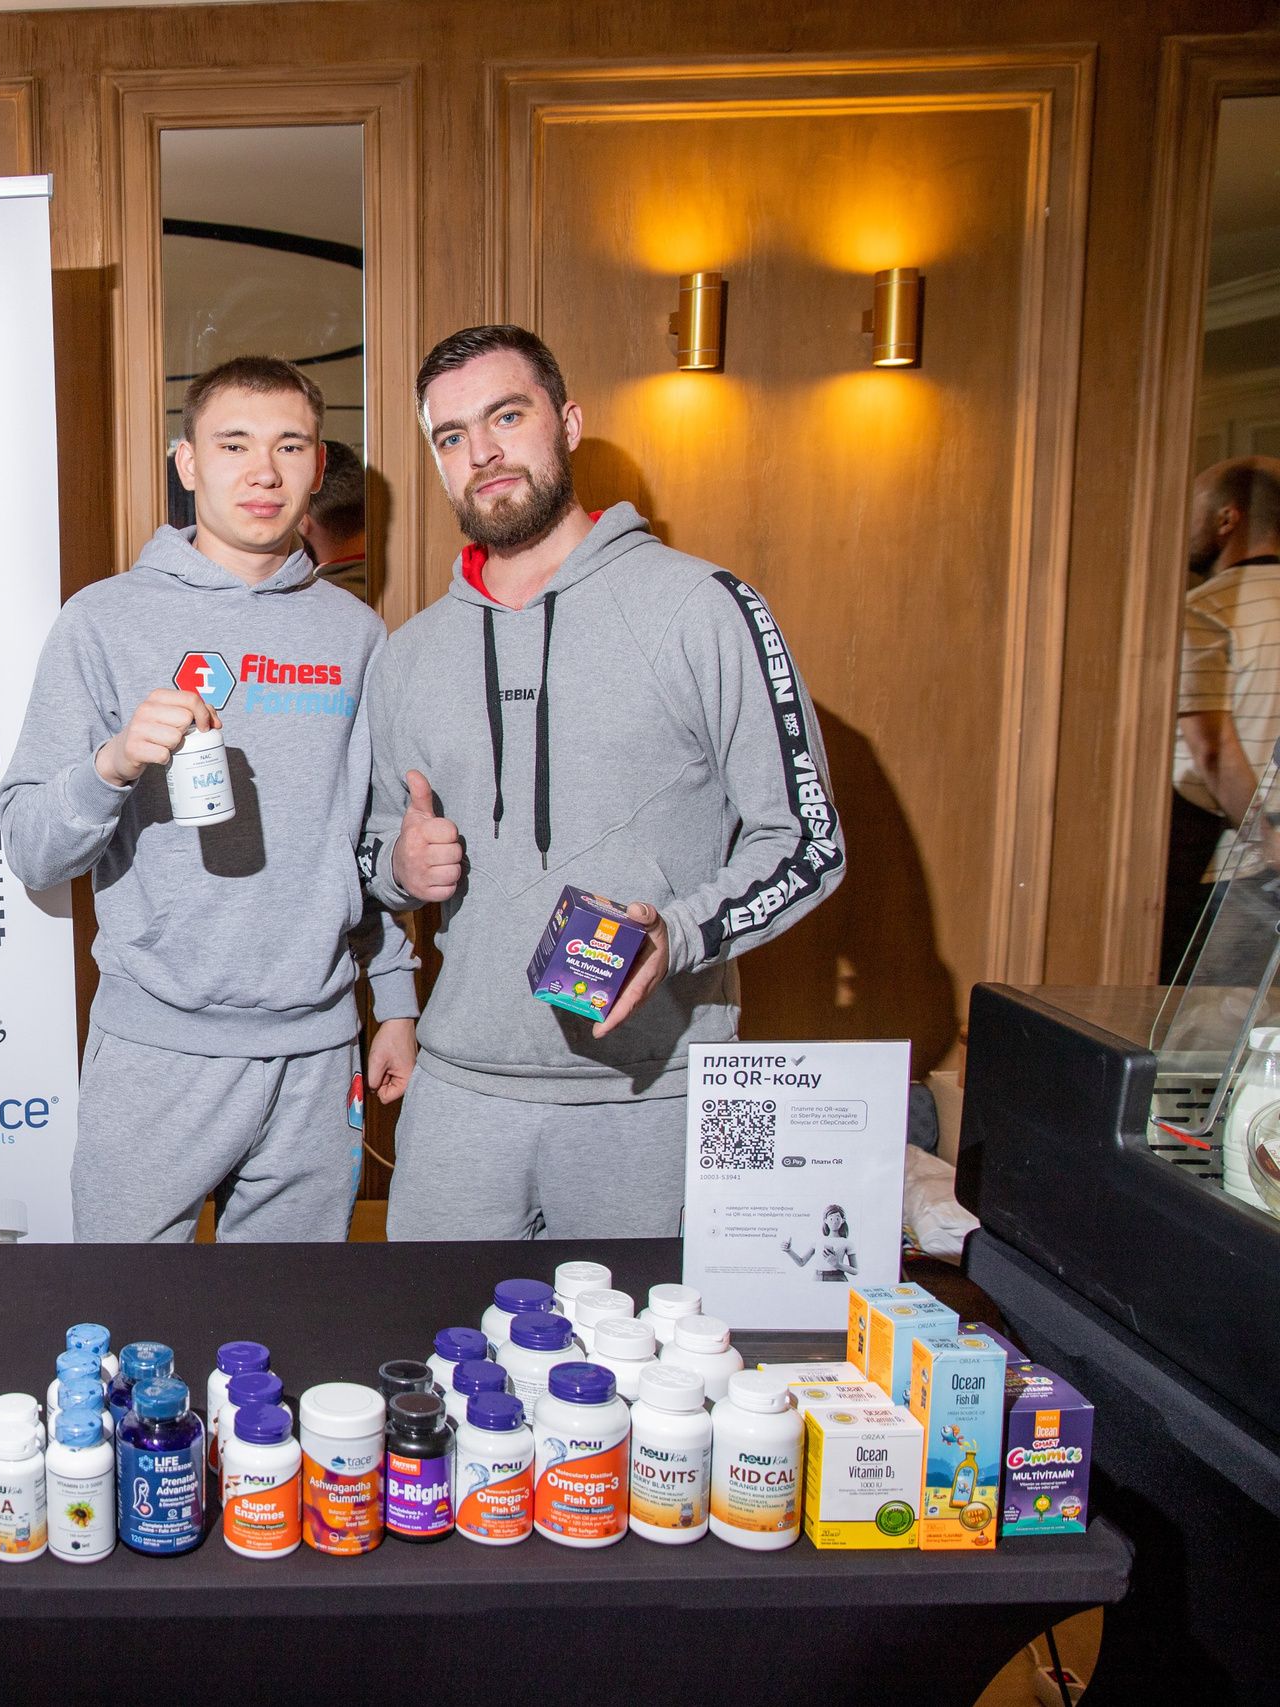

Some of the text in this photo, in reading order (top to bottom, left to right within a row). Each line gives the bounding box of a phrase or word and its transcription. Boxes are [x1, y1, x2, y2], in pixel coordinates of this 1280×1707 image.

[736, 582, 794, 704] NEBBIA
[240, 654, 342, 686] Fitness
[245, 684, 355, 718] Formula
[499, 689, 535, 701] EBBIA
[192, 770, 224, 789] NAC
[567, 940, 624, 968] Gummies
[703, 1055, 786, 1068] платите
[703, 1070, 822, 1088] по QR-коду
[952, 1374, 985, 1390] Ocean
[956, 1394, 979, 1405] Fish Oil
[1036, 1426, 1058, 1437] Ocean
[570, 1439, 602, 1451] now
[1033, 1439, 1059, 1448] SMART
[155, 1456, 179, 1466] LIFE
[347, 1456, 372, 1466] trace
[640, 1446, 687, 1463] now Kids
[739, 1453, 788, 1466] now Kids
[856, 1447, 888, 1462] Ocean
[1007, 1450, 1082, 1469] Gummies
[492, 1461, 522, 1473] now
[633, 1459, 696, 1483] KID VITS
[849, 1466, 883, 1478] Vitamin
[162, 1472, 195, 1487] Prenatal
[244, 1474, 275, 1486] now
[590, 1471, 613, 1479] Distilled
[730, 1465, 795, 1485] KID CAL
[156, 1481, 198, 1497] Advantage
[310, 1476, 371, 1494] Ashwagandha
[547, 1472, 619, 1496] Omega-3
[652, 1480, 676, 1490] BLAST
[729, 1480, 795, 1492] ORANGE DELICIOUS
[328, 1492, 370, 1503] Gummies
[389, 1478, 448, 1505] B-Right
[477, 1489, 529, 1506] Omega-3
[242, 1499, 276, 1512] Super
[564, 1494, 603, 1505] Fish Oil
[234, 1505, 284, 1522] Enzymes
[967, 1509, 983, 1517] FISH
[131, 1534, 142, 1543] 120
